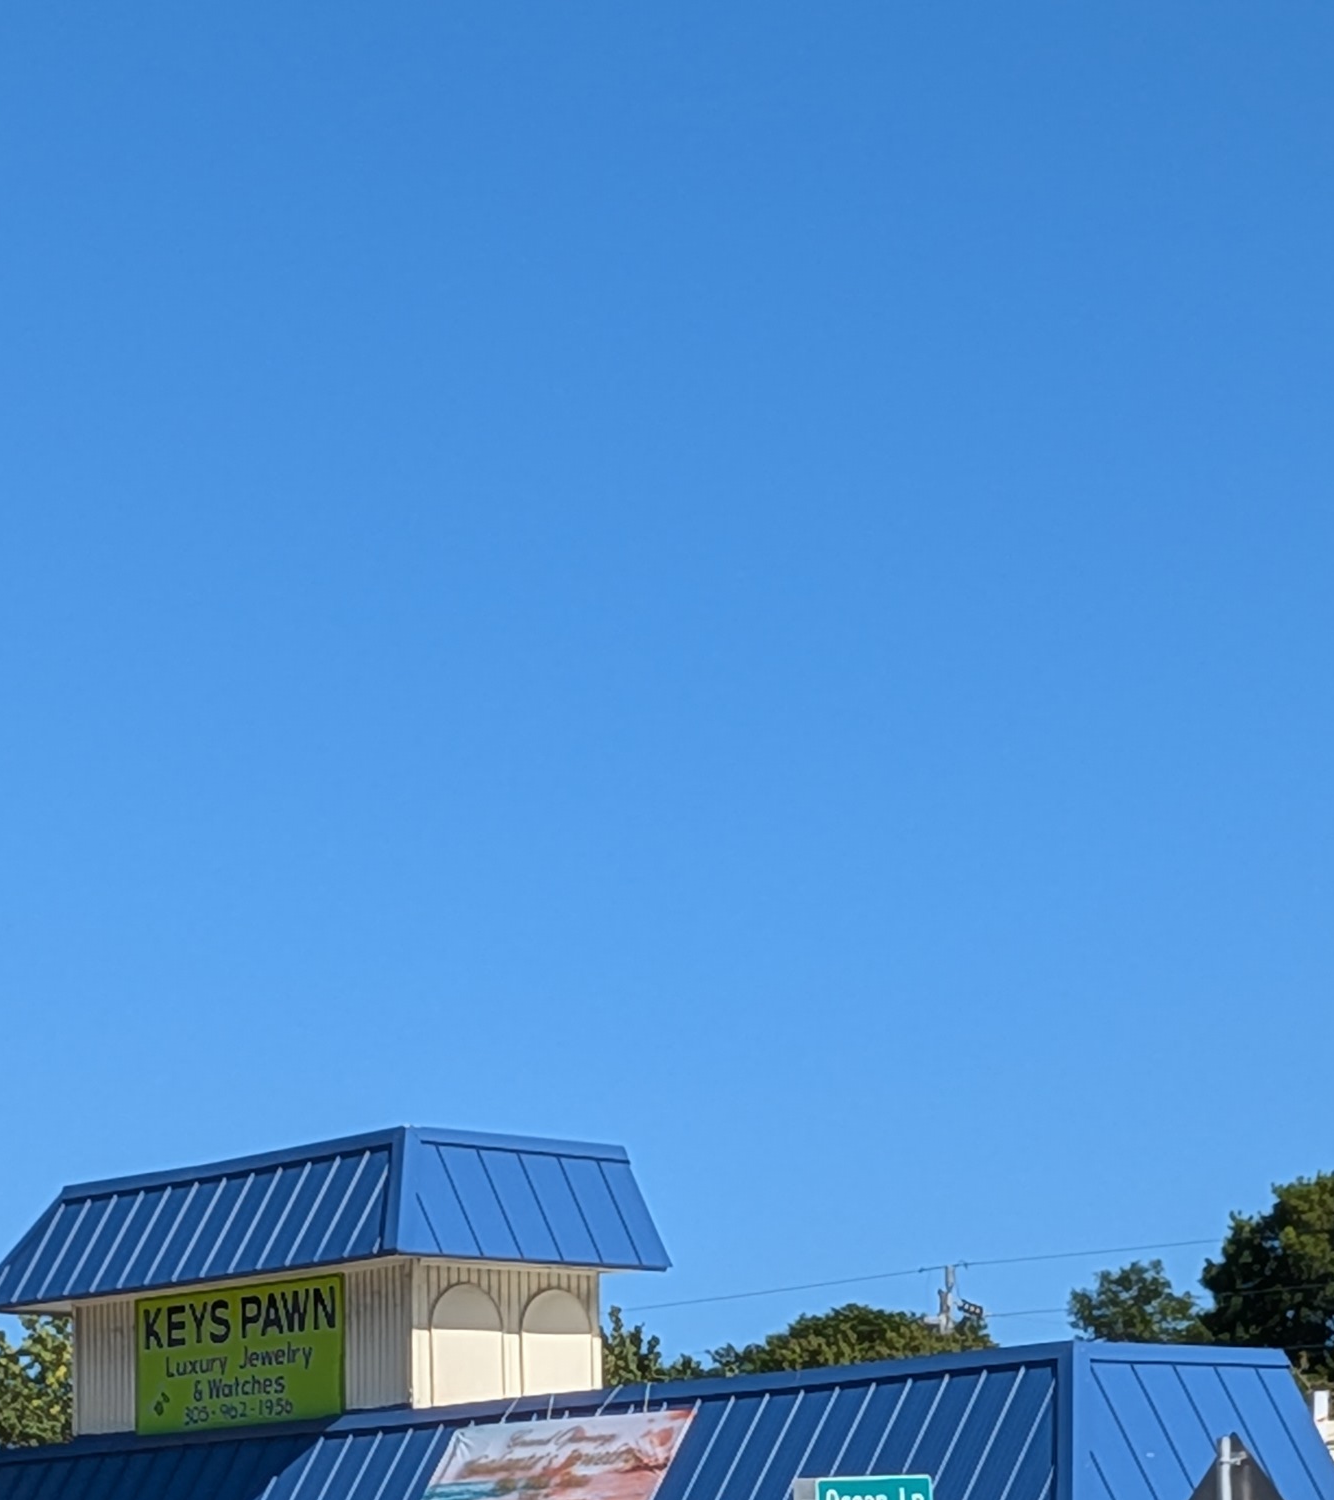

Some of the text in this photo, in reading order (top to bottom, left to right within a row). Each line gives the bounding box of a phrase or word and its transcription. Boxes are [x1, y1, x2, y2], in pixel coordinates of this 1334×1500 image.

[143, 1286, 336, 1350] KEYS PAWN
[166, 1342, 313, 1378] Luxury Jewelry
[208, 1375, 285, 1400] Watches
